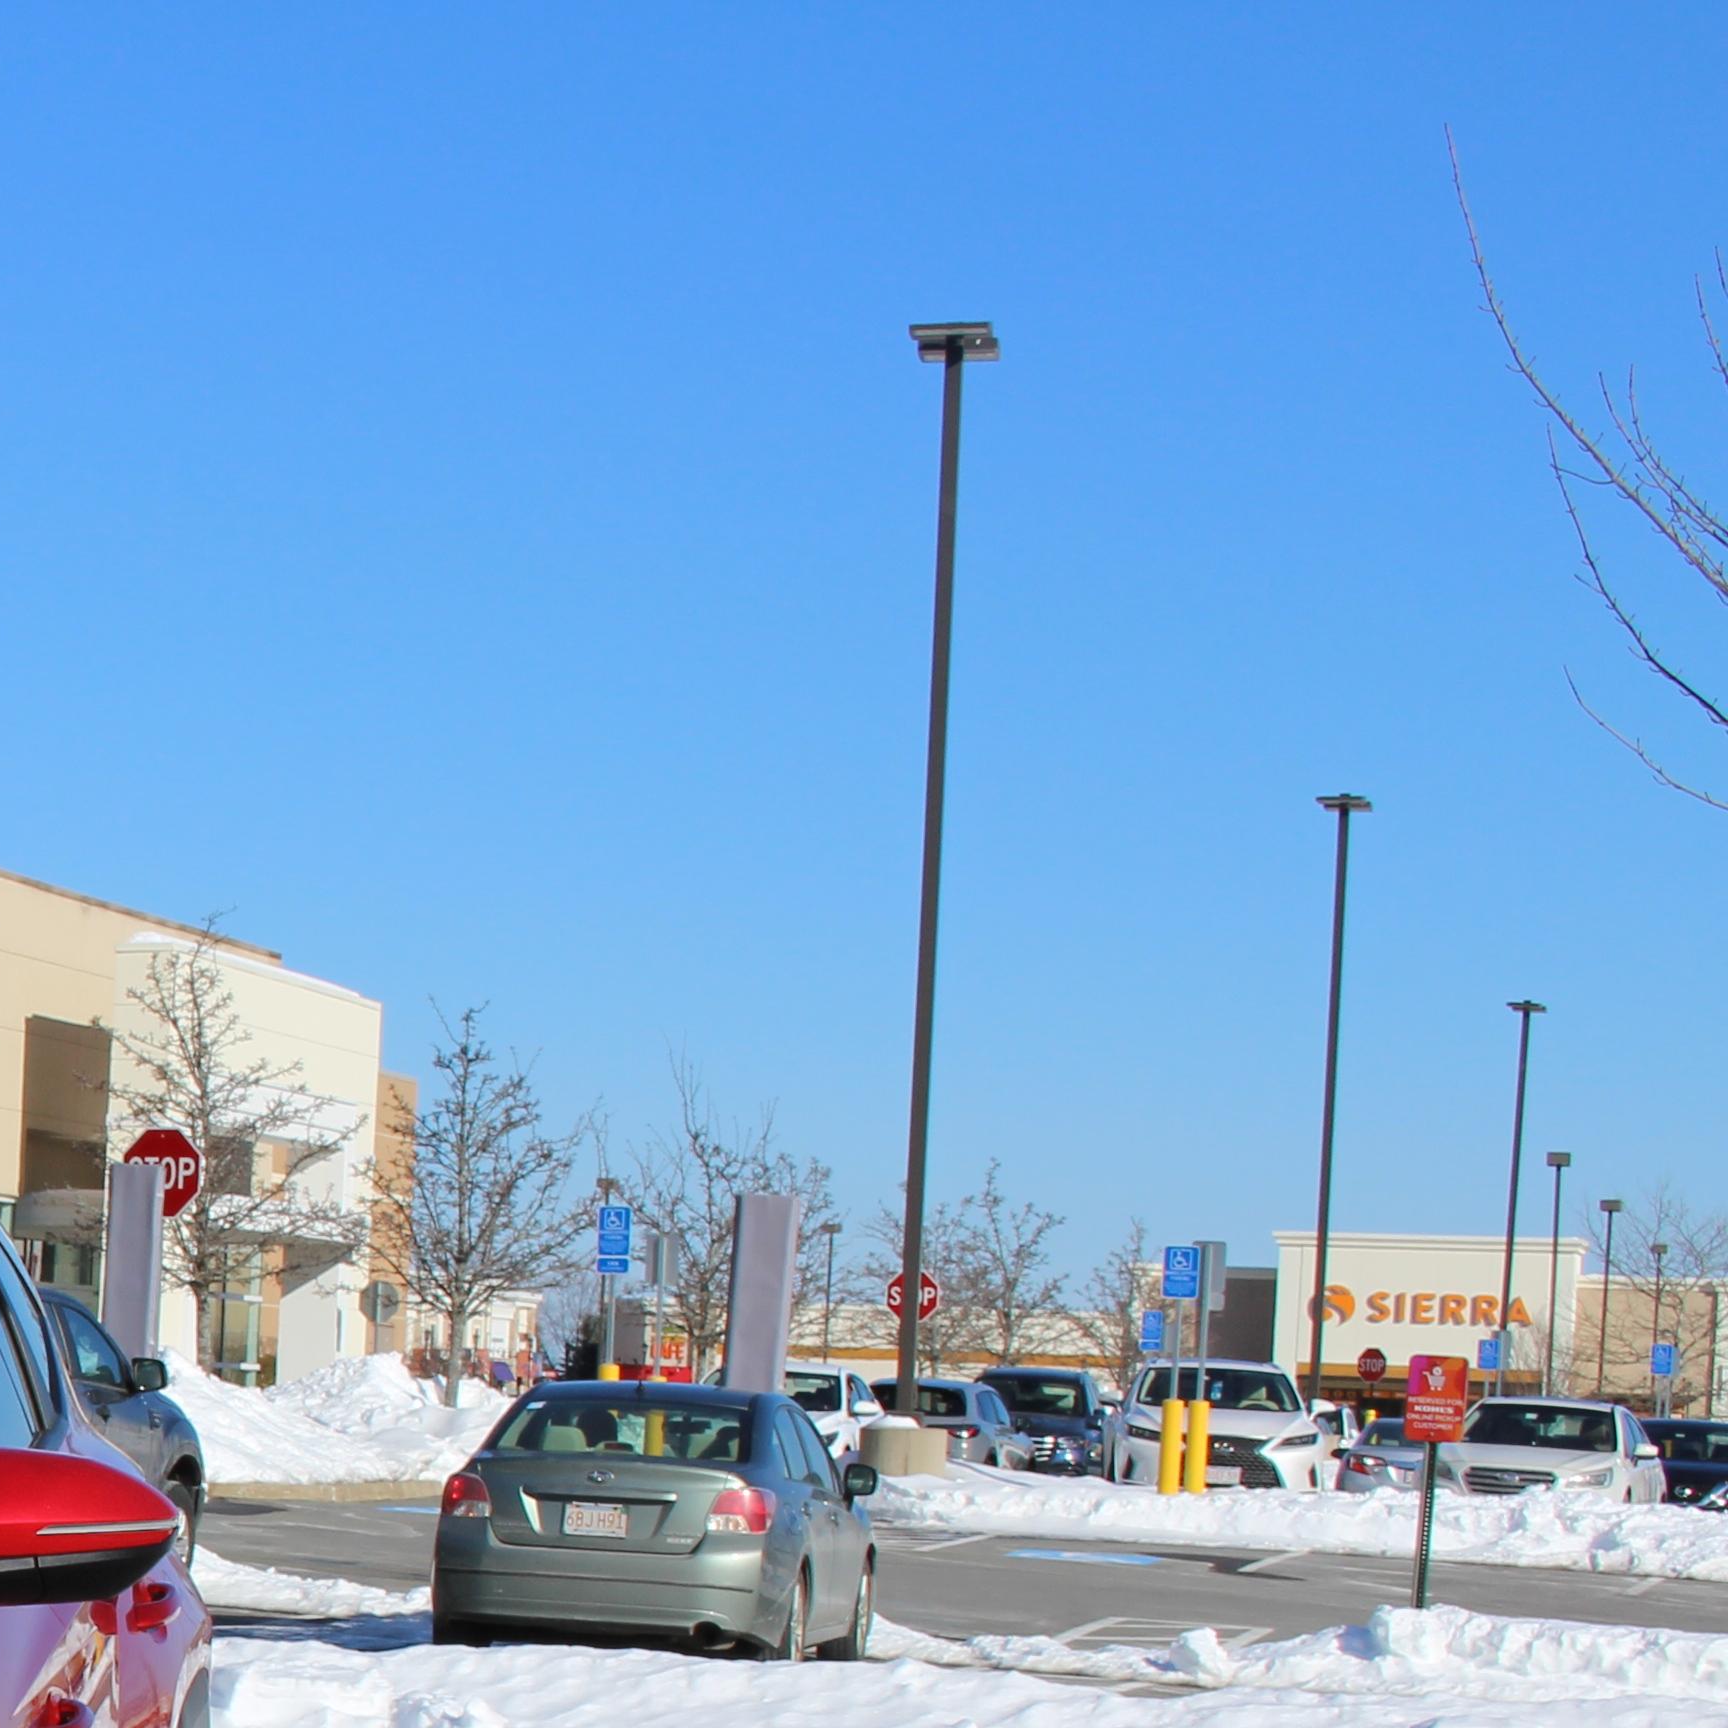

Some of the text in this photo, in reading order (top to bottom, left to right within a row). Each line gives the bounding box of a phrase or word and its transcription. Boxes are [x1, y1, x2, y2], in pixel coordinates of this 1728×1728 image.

[889, 1286, 936, 1306] SP
[1365, 1290, 1534, 1328] SIERRA
[1358, 1358, 1385, 1372] STOP
